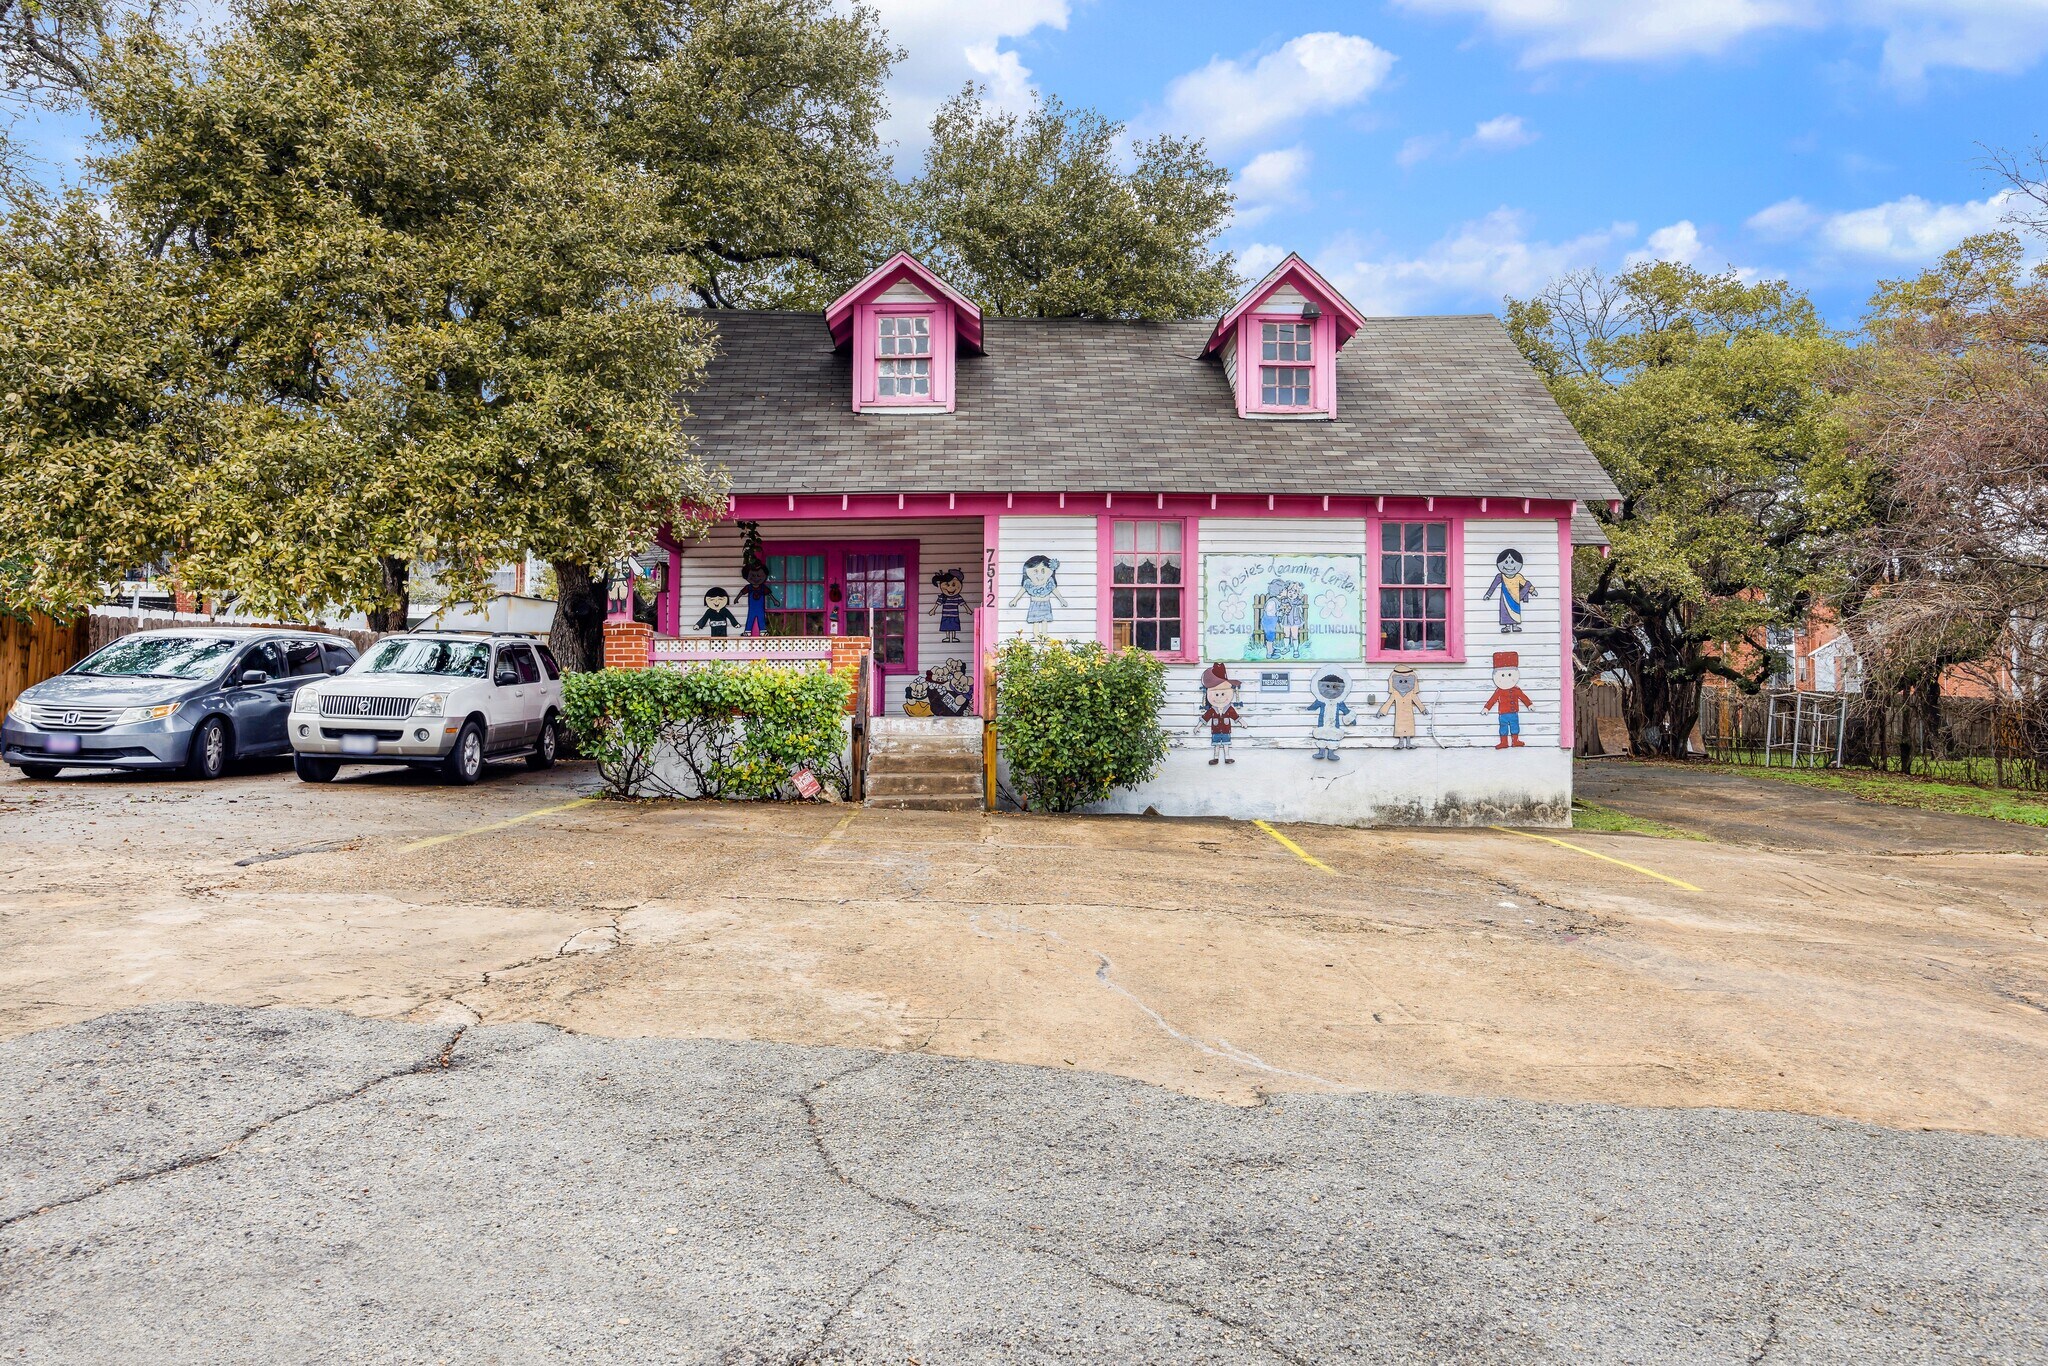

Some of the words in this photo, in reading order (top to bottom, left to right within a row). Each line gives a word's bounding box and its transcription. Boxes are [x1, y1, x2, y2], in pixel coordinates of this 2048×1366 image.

[986, 548, 996, 608] 7512
[1218, 563, 1265, 597] Rosie's
[1268, 557, 1320, 582] Learning
[1321, 566, 1358, 593] Center
[1207, 623, 1252, 635] 452-5419
[1309, 623, 1360, 635] BILINGUAL
